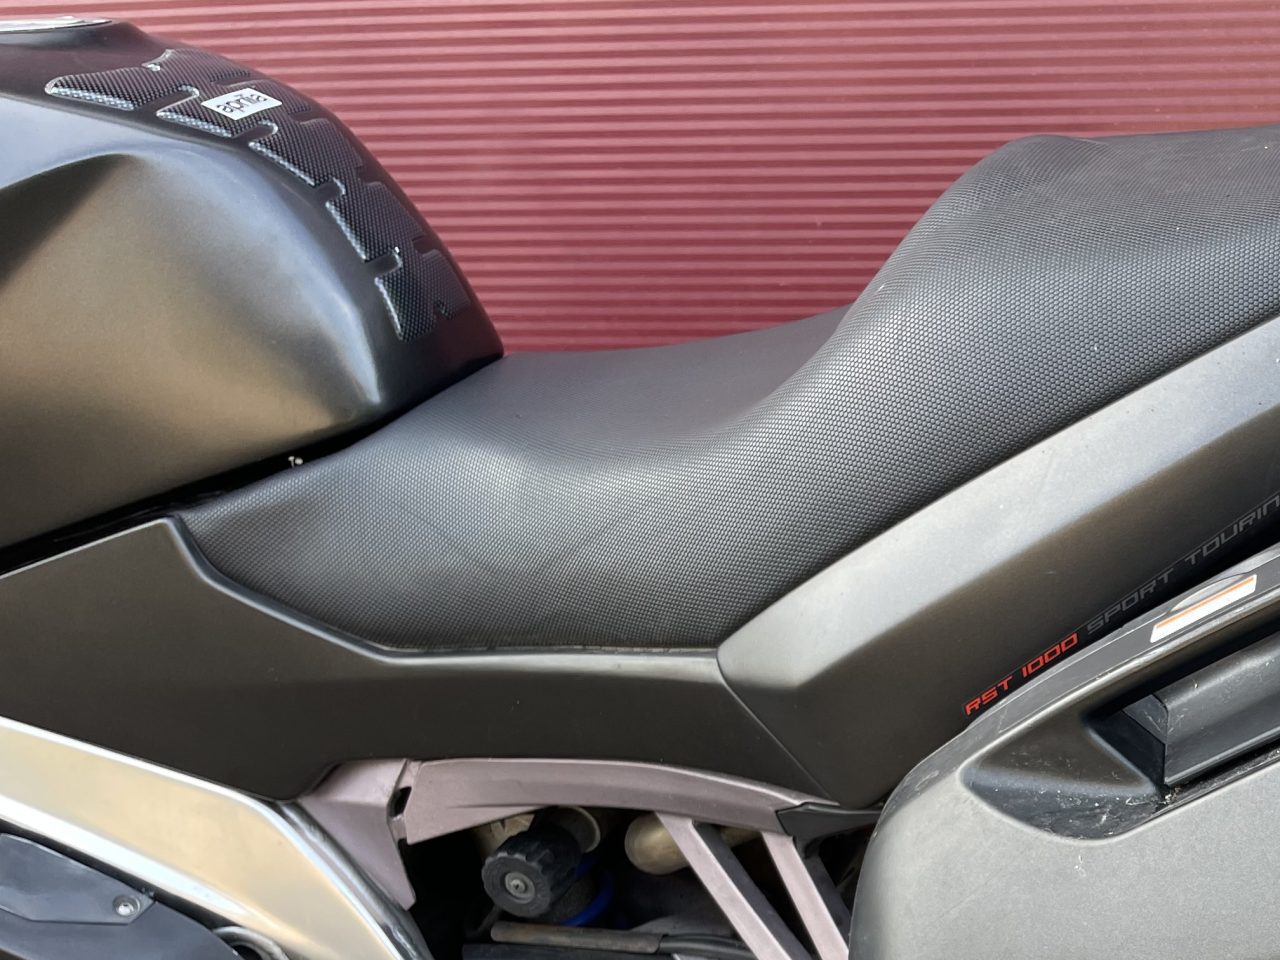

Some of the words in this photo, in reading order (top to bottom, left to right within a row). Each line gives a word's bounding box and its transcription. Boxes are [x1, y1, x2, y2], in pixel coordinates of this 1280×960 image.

[965, 675, 1013, 716] RST
[1021, 632, 1078, 678] 1000
[1087, 567, 1174, 635] SPORT
